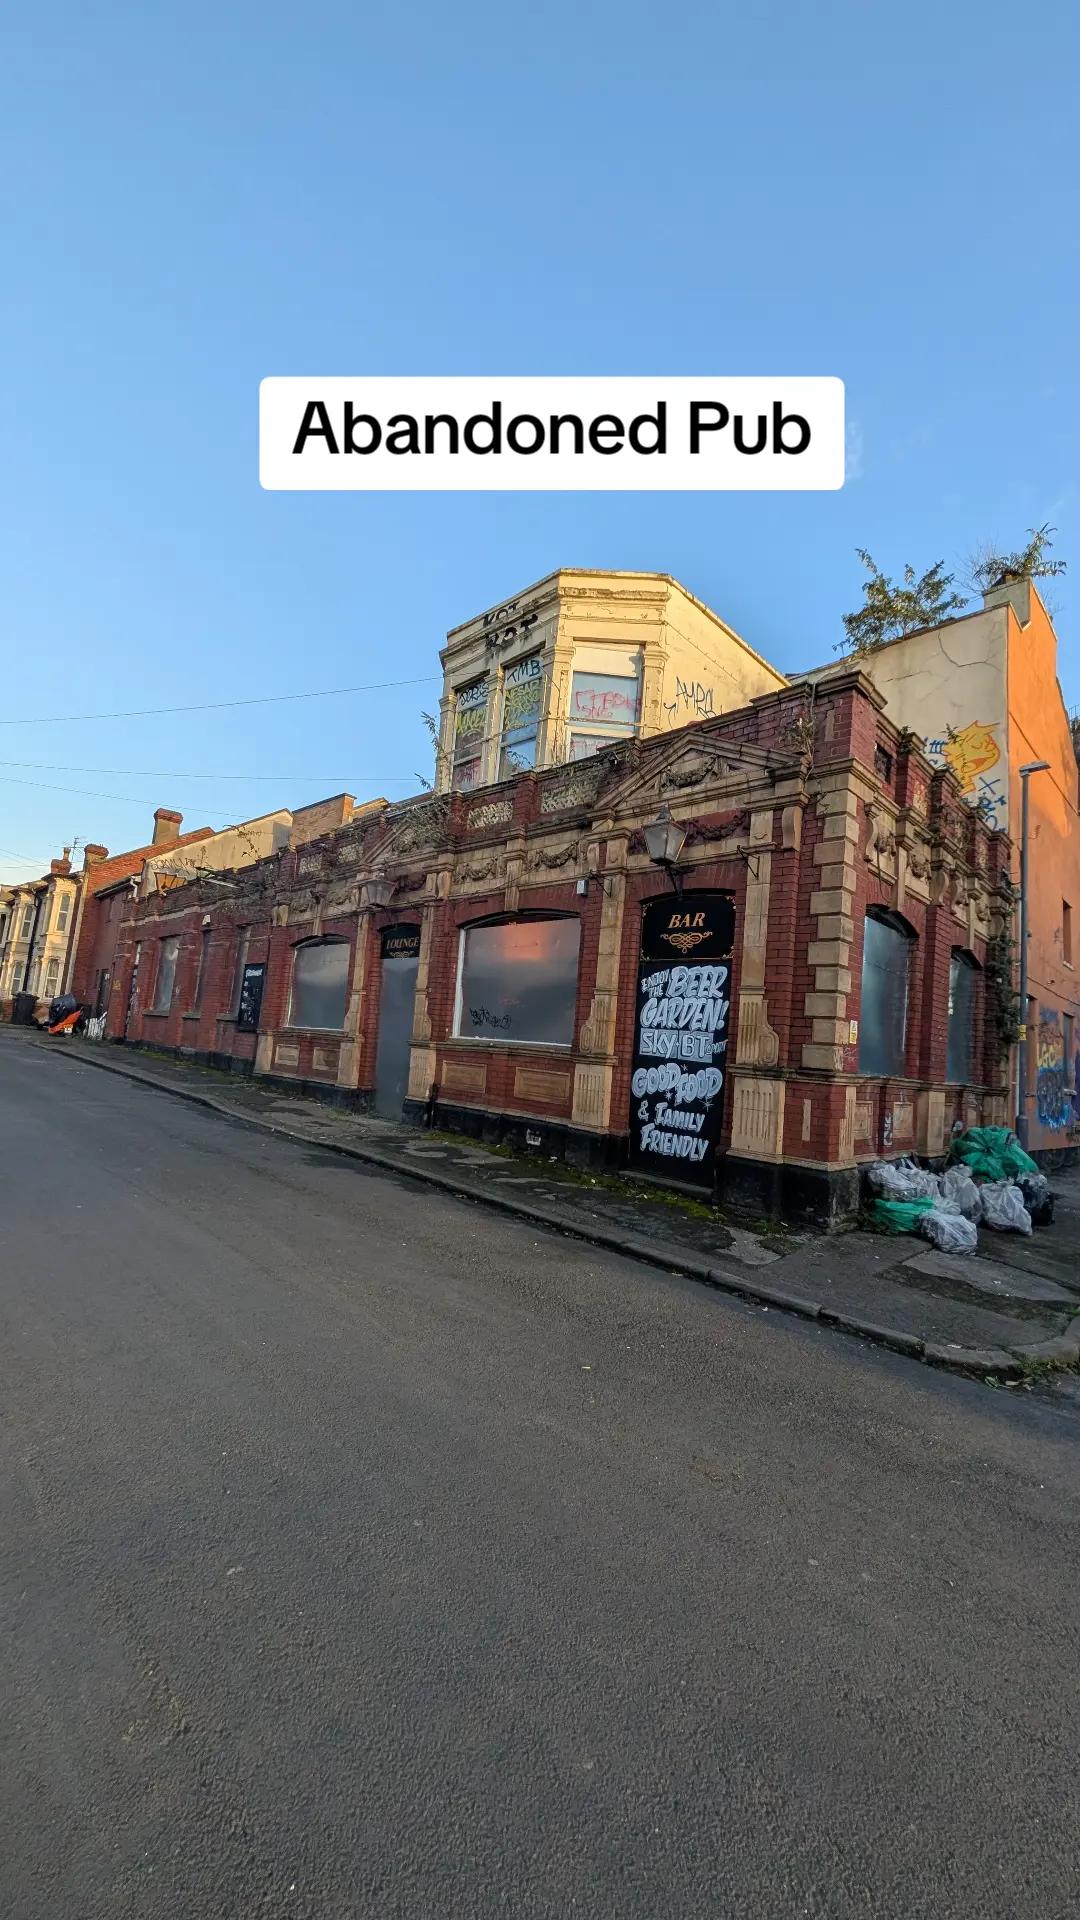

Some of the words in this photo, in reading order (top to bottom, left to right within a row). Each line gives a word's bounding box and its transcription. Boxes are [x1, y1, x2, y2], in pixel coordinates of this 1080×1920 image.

[667, 912, 706, 929] BAR
[386, 936, 419, 949] LOUNGE
[640, 969, 670, 993] ENJOY
[648, 983, 664, 998] THE
[665, 965, 728, 998] BEER
[640, 997, 729, 1033] GARDEN!
[641, 1030, 676, 1058] SKY
[631, 1062, 681, 1098] GOOD
[674, 1067, 724, 1107] FOOD
[637, 1100, 650, 1122] &
[654, 1102, 706, 1133] FAMILY
[640, 1122, 710, 1162] FRIENDLY
